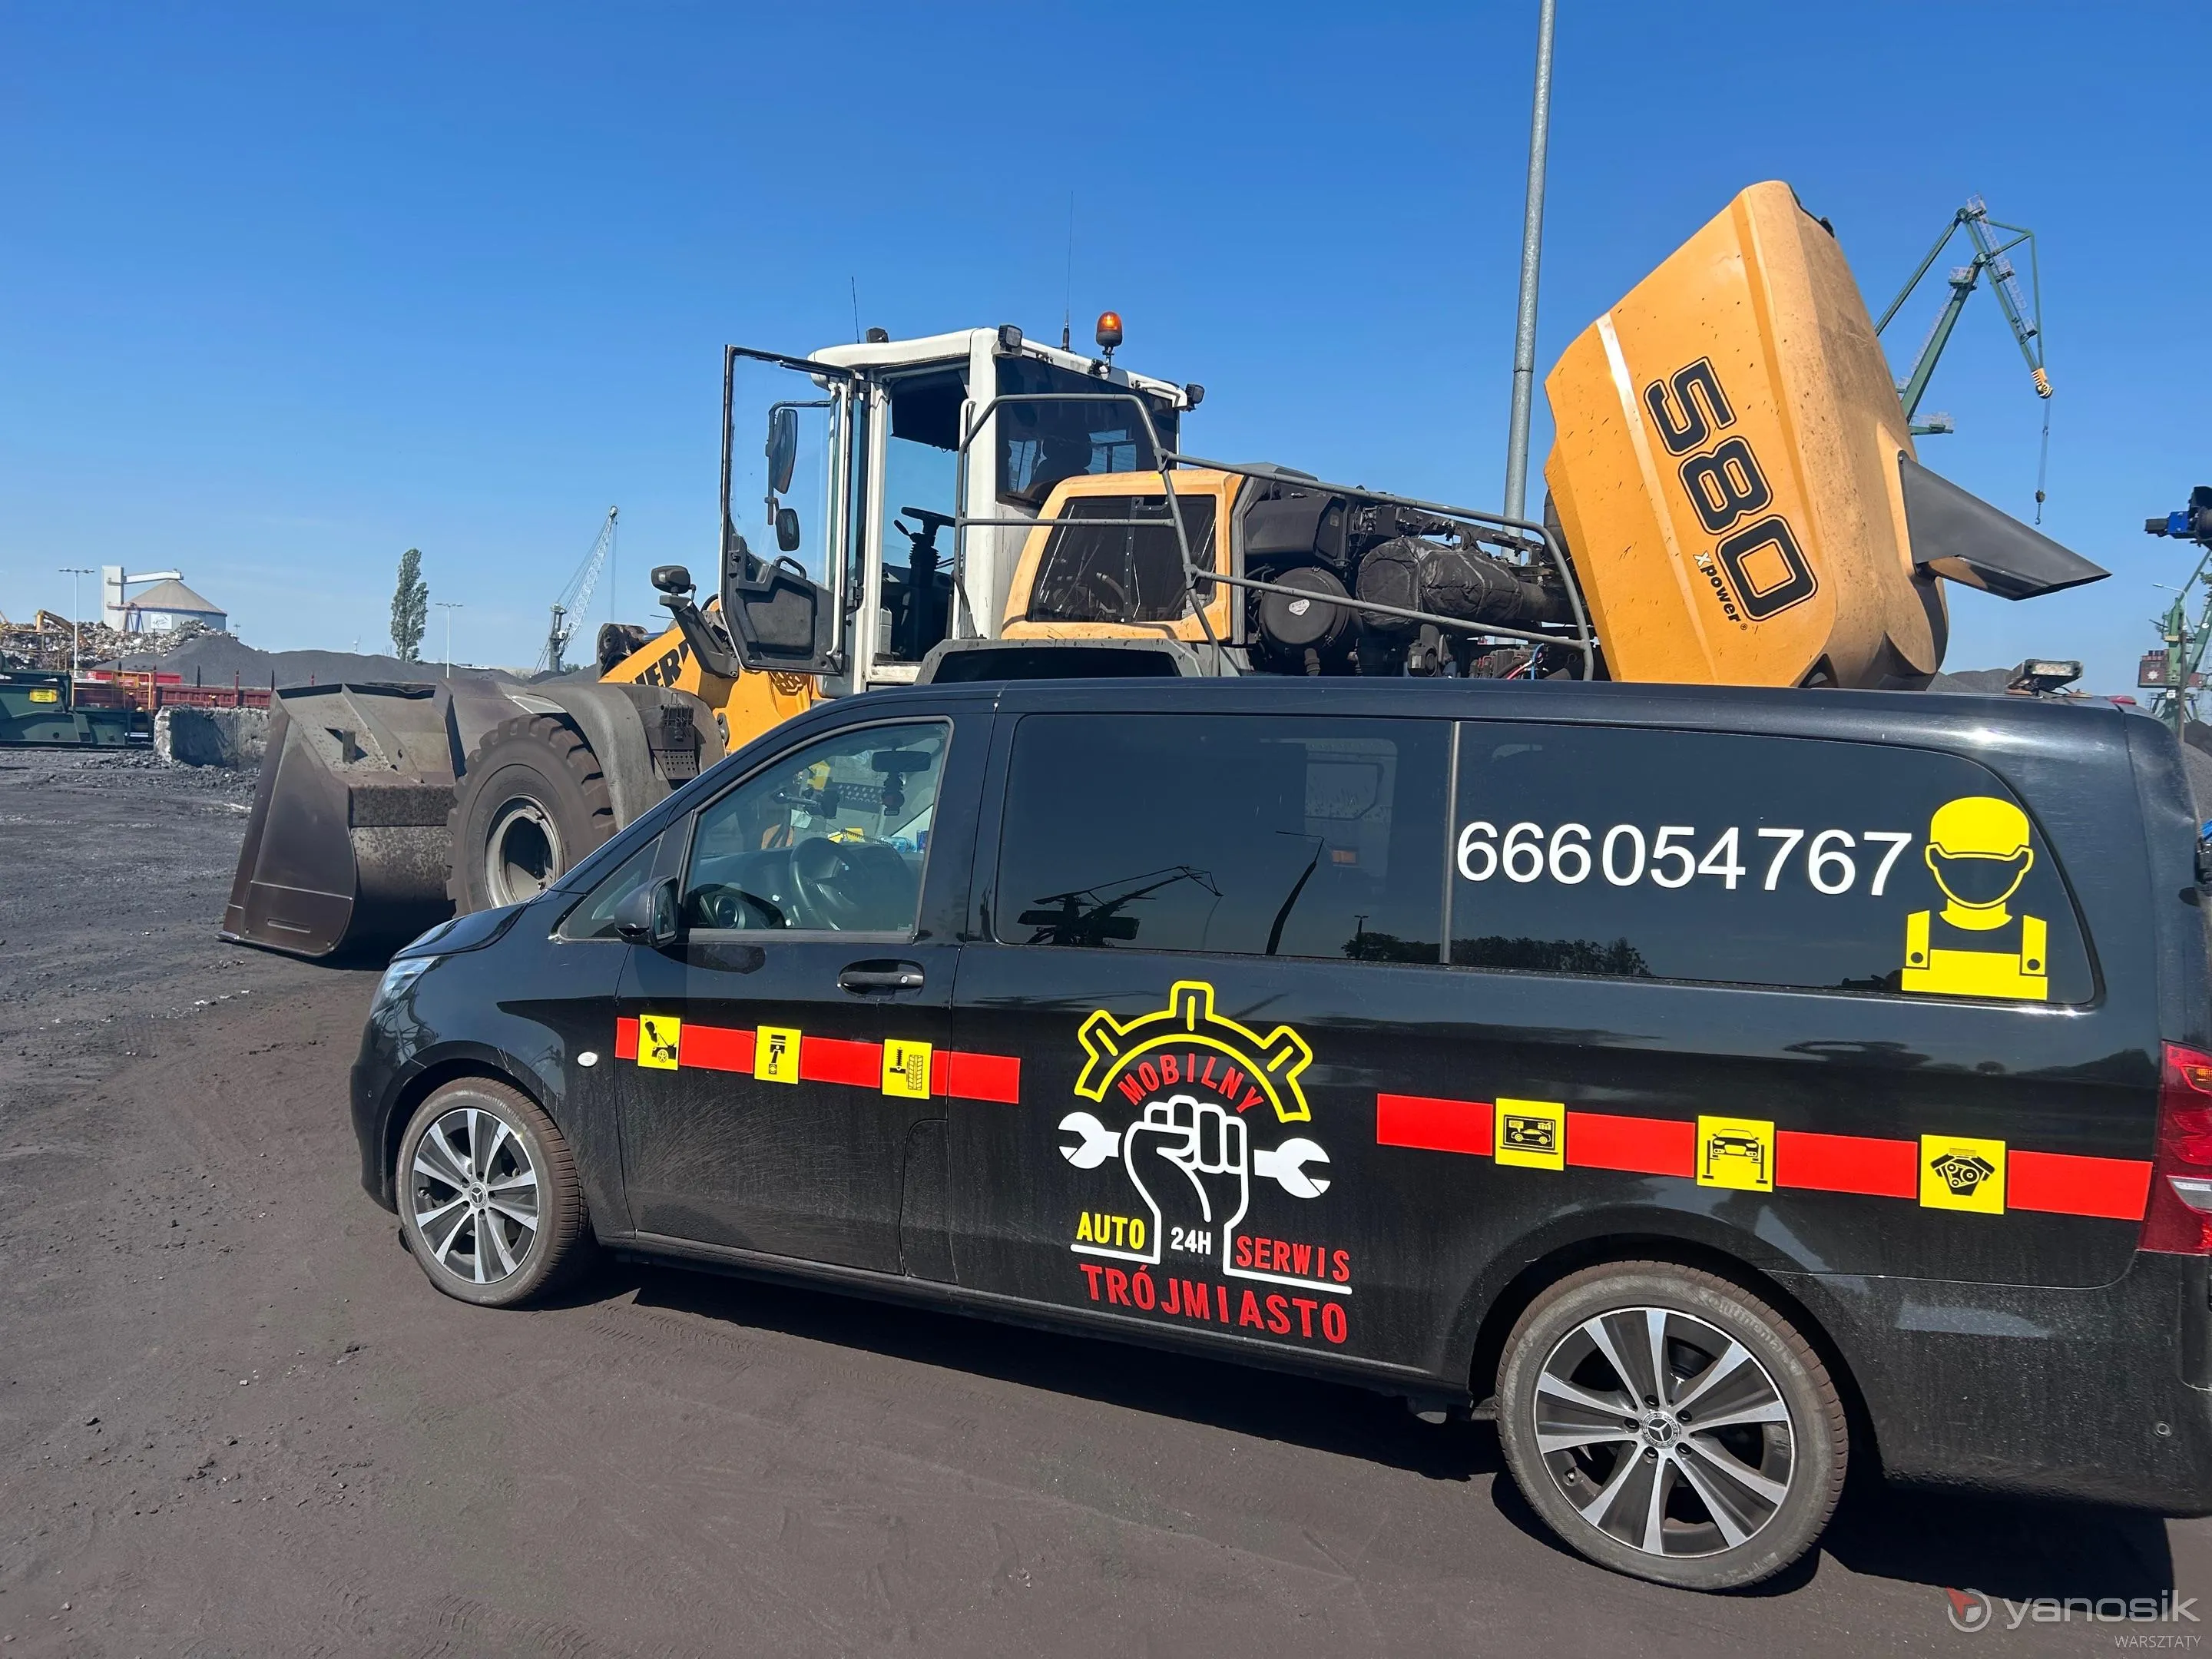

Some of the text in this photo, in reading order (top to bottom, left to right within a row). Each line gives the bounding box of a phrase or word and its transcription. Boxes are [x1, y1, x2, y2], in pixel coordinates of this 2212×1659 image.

[1644, 356, 1818, 621] 580
[1118, 1053, 1264, 1114] MOBILNY
[1076, 1212, 1349, 1283] AUTO 24H SERWIS
[1080, 1263, 1348, 1344] TRÓJMIASTO
